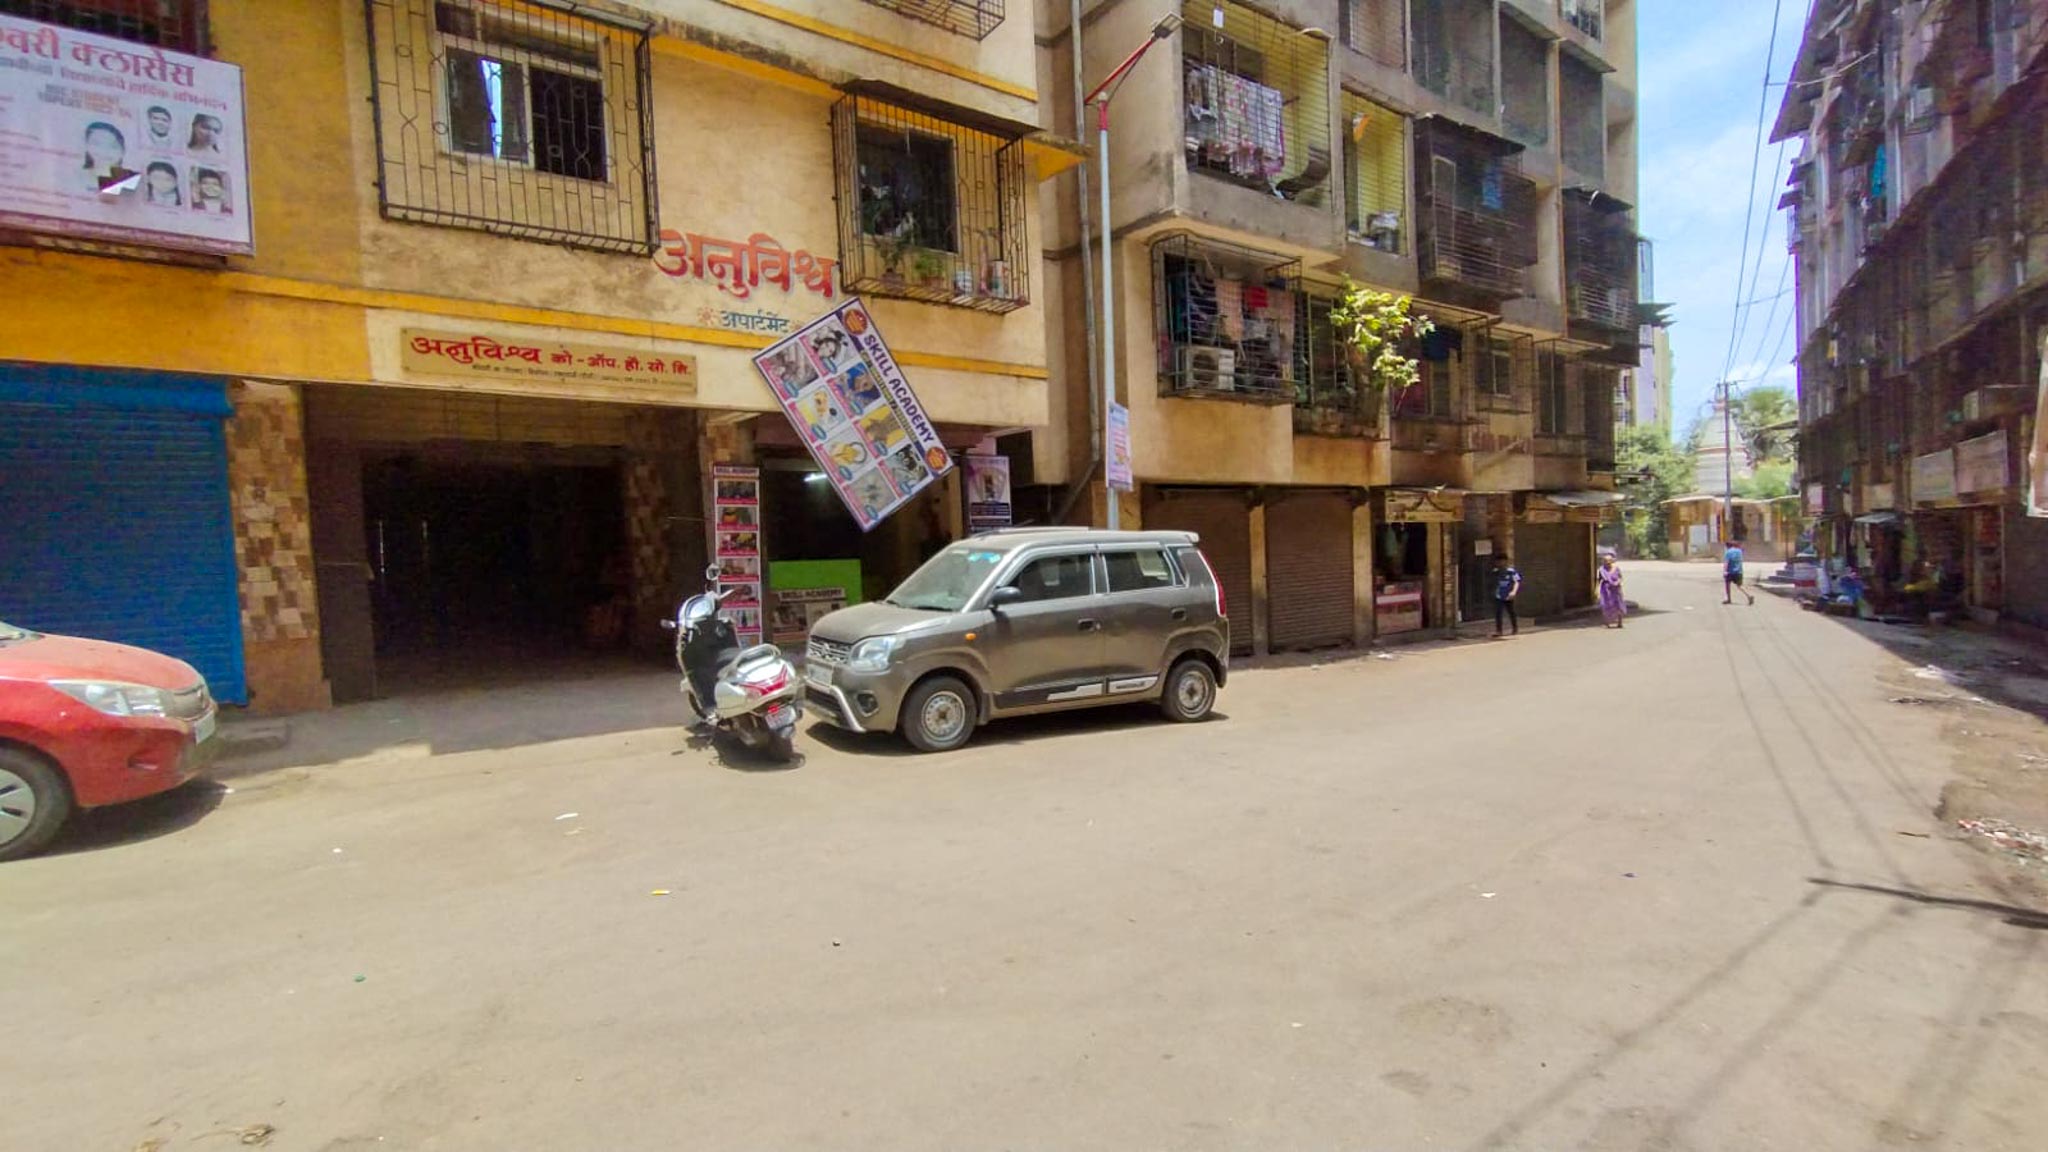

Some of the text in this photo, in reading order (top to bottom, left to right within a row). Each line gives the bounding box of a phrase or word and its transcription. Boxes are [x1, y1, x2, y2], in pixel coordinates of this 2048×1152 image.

[0, 26, 60, 59] वरी
[70, 41, 195, 87] क्लासेस
[864, 334, 894, 377] SKILL
[888, 377, 936, 444] ACADEMY
